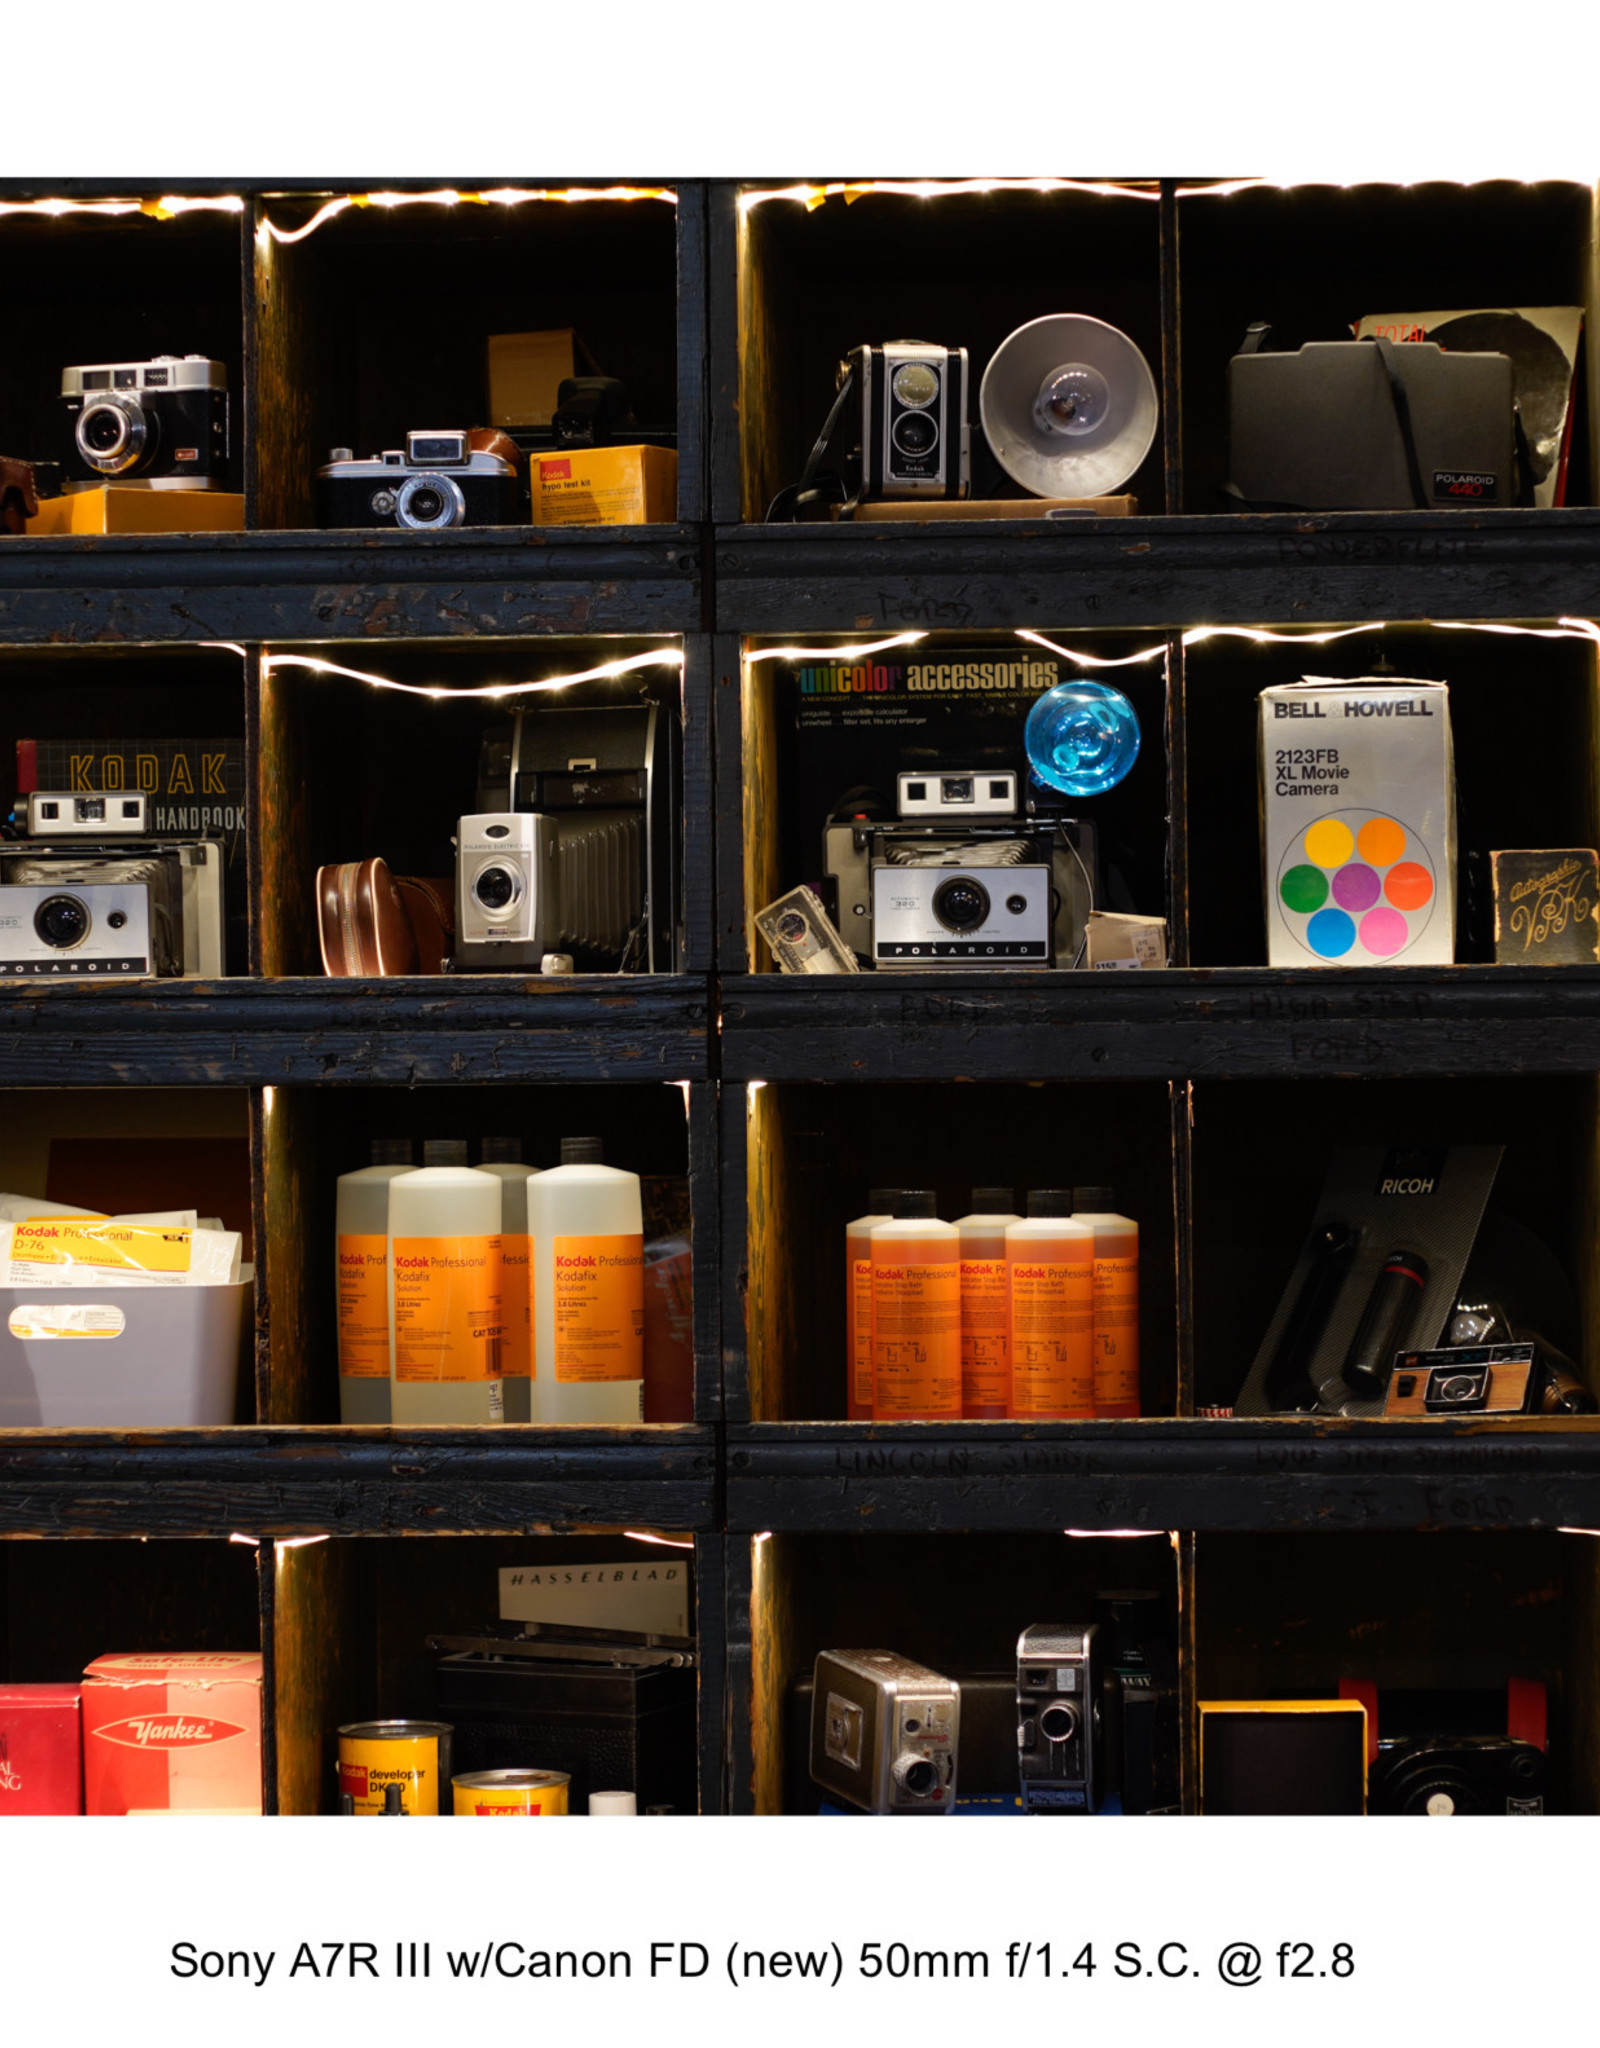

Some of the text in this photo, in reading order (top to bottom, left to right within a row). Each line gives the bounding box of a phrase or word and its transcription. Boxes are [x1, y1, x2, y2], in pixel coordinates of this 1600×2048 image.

[541, 469, 566, 480] Kodak
[1436, 474, 1495, 485] POLAROID
[541, 478, 592, 492] hypo test kit
[1448, 482, 1483, 496] 440
[800, 654, 1059, 693] unicolor accessories
[1274, 699, 1433, 719] BELL & HOWELL
[1275, 749, 1339, 764] 2123FB
[69, 753, 227, 794] KODAK
[1275, 765, 1350, 780] XL Movie
[1275, 781, 1339, 797] Camera
[156, 806, 246, 831] HANDBOOK
[895, 945, 1028, 955] POLAROID
[0, 962, 130, 973] POLAROID
[1381, 1178, 1436, 1195] RICOH
[16, 1225, 60, 1238] Kodak
[14, 1239, 46, 1251] D-76
[339, 1254, 388, 1265] Kodak Prof
[395, 1255, 487, 1269] Kodak Professional
[555, 1254, 645, 1267] Kodak Professiona
[555, 1269, 598, 1282] Kodafix
[875, 1269, 905, 1280] Kodak
[960, 1263, 993, 1275] Kodak
[1014, 1267, 1046, 1279] Kodak
[395, 1270, 431, 1282] Kodafix
[396, 1284, 422, 1293] Solution
[556, 1284, 587, 1293] Solution
[511, 1568, 678, 1586] HASSELBLAD
[127, 1716, 214, 1746] Yankee
[341, 1764, 367, 1779] Kodak
[369, 1768, 426, 1781] developer
[369, 1782, 406, 1793] DK0
[488, 1807, 528, 1816] Kodak
